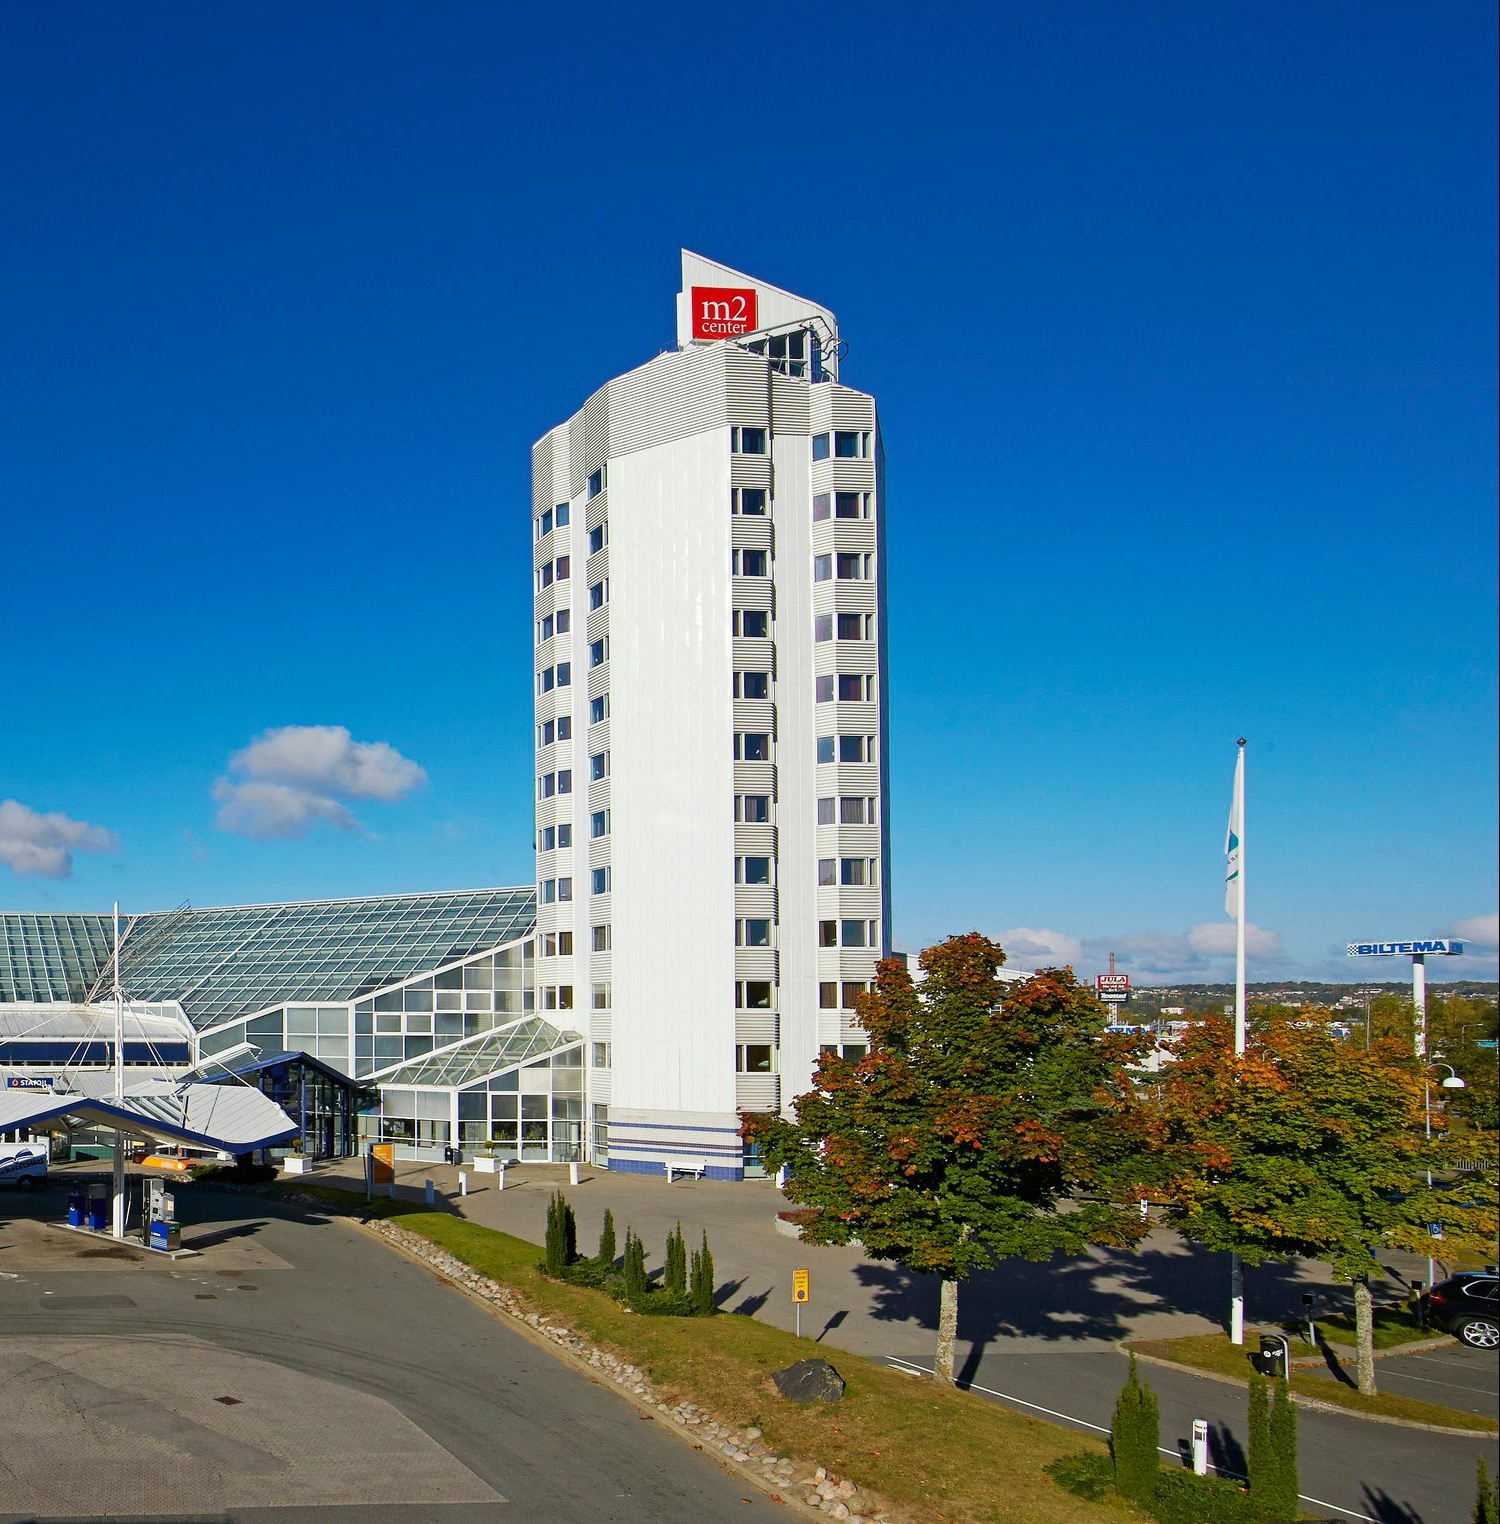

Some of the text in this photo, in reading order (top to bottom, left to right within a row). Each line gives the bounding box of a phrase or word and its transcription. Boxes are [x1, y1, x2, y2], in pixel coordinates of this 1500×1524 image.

[701, 296, 747, 321] m2
[701, 321, 747, 334] center
[1357, 941, 1447, 955] BILTEMA
